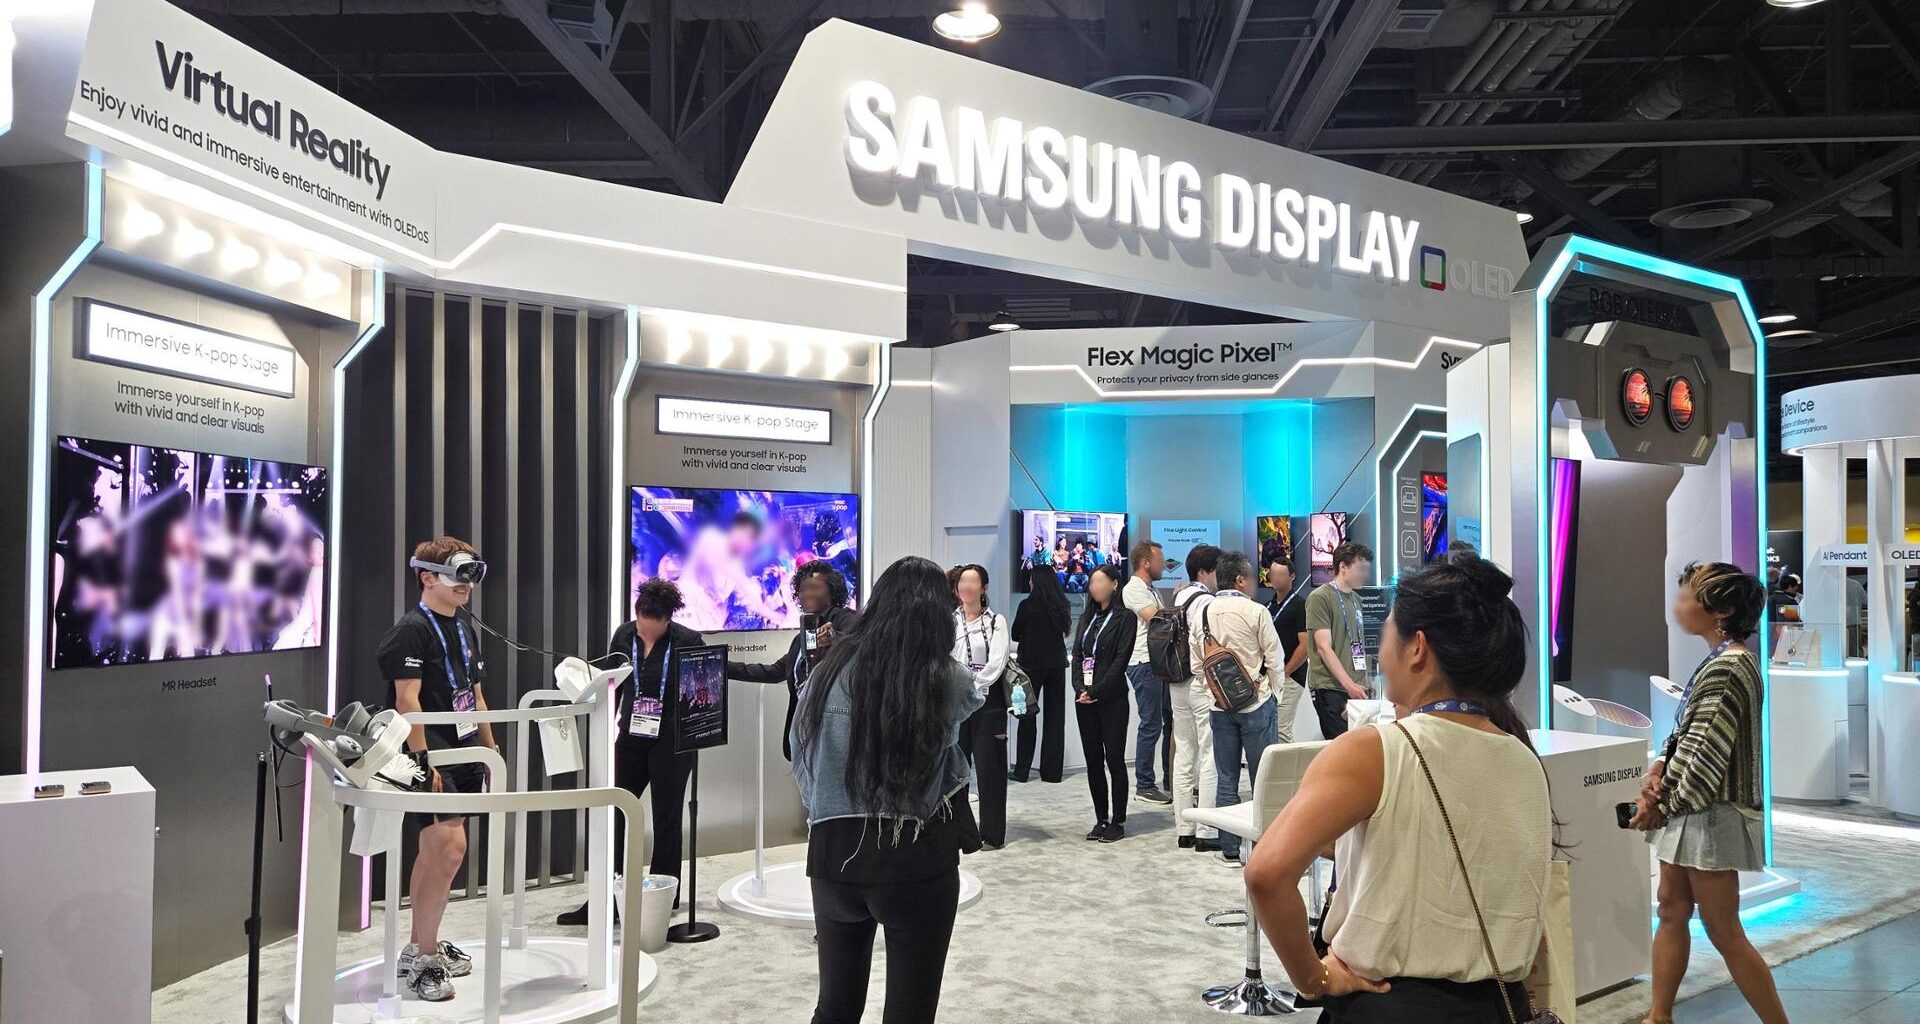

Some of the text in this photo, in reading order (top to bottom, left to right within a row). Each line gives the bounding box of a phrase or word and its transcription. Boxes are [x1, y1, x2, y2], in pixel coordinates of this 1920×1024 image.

[155, 40, 391, 200] Virtual Reality
[80, 80, 430, 244] Enjoy vivid and immersive entertainment with OLEDoS
[846, 80, 1421, 282] SAMSUNG DISPLAY
[1449, 258, 1514, 300] OLED
[106, 322, 279, 377] Immersive K-pop Stage
[1087, 346, 1134, 366] Flex
[1140, 343, 1217, 370] Magic
[1097, 371, 1279, 385] Protects your privacy from side glances
[117, 381, 265, 418] Immerse yourself in K-pop
[1785, 399, 1815, 417] Device
[114, 401, 265, 434] with vivid and clear visuals
[673, 408, 818, 431] Immersive K-pop Stage
[681, 458, 807, 473] with vivid and clear visuals
[683, 446, 807, 463] Immerse yourself in K-pop
[1822, 551, 1868, 560] AI Pendant
[734, 644, 767, 652] Headset
[162, 676, 217, 691] MR Headset
[1583, 766, 1642, 788] SAMSUNG DISPLAY
